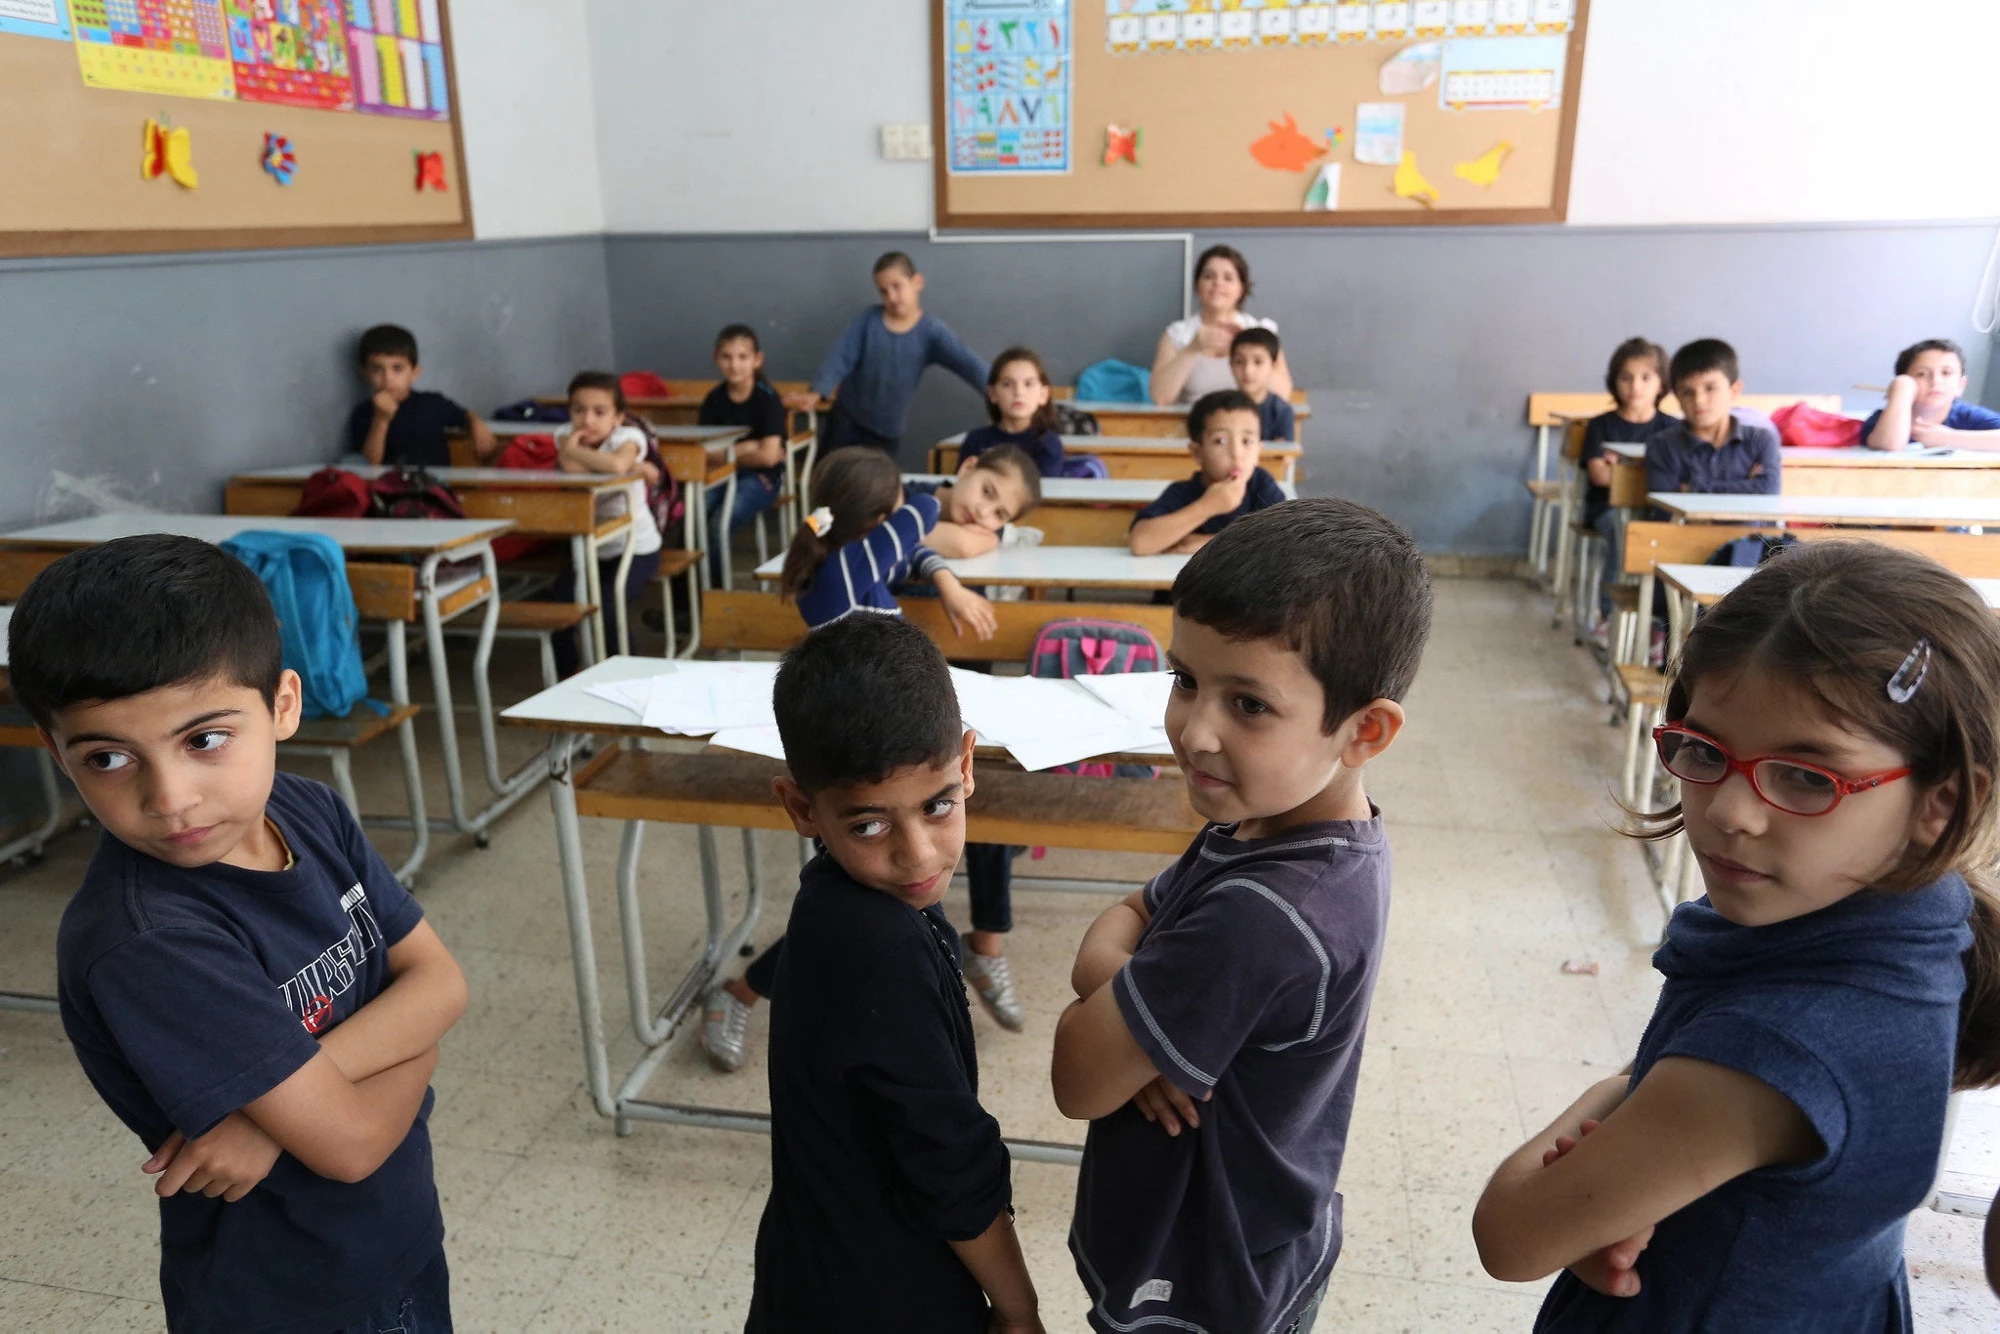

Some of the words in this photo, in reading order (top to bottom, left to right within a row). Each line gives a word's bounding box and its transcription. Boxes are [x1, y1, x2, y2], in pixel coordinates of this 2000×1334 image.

[977, 20, 992, 51] ٤
[999, 20, 1019, 49] ٣
[1025, 20, 1039, 47] ٢
[1049, 18, 1060, 48] ١
[979, 97, 992, 125] ٩
[998, 98, 1020, 125] ٨
[1020, 96, 1041, 124] ٧
